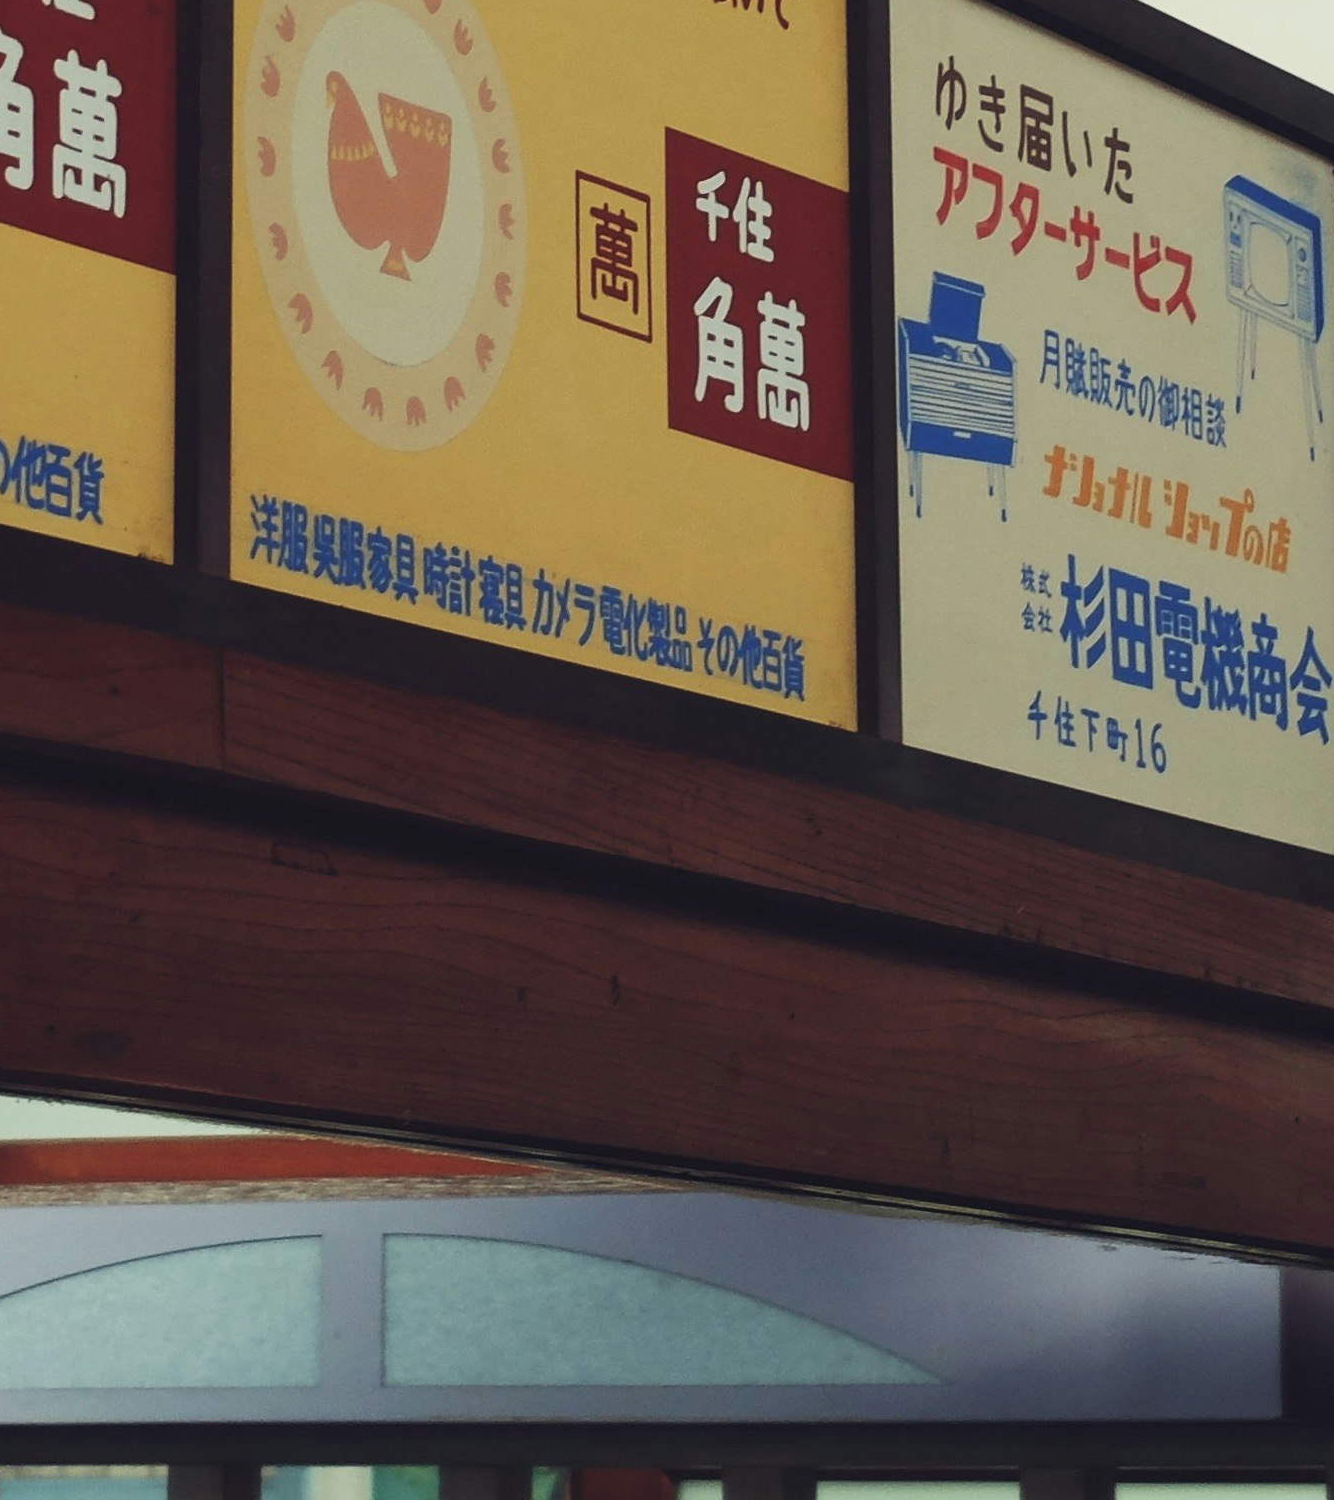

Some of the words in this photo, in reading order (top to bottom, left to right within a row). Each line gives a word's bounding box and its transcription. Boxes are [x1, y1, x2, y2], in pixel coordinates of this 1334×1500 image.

[935, 56, 1133, 204] ゆき届いた
[590, 203, 639, 315] 萬
[696, 171, 774, 262] 千住
[933, 147, 1197, 325] アフターサービス
[694, 277, 809, 431] 角萬
[1059, 553, 1333, 745] 杉田電機商会
[1027, 690, 1167, 774] 千住下町16
